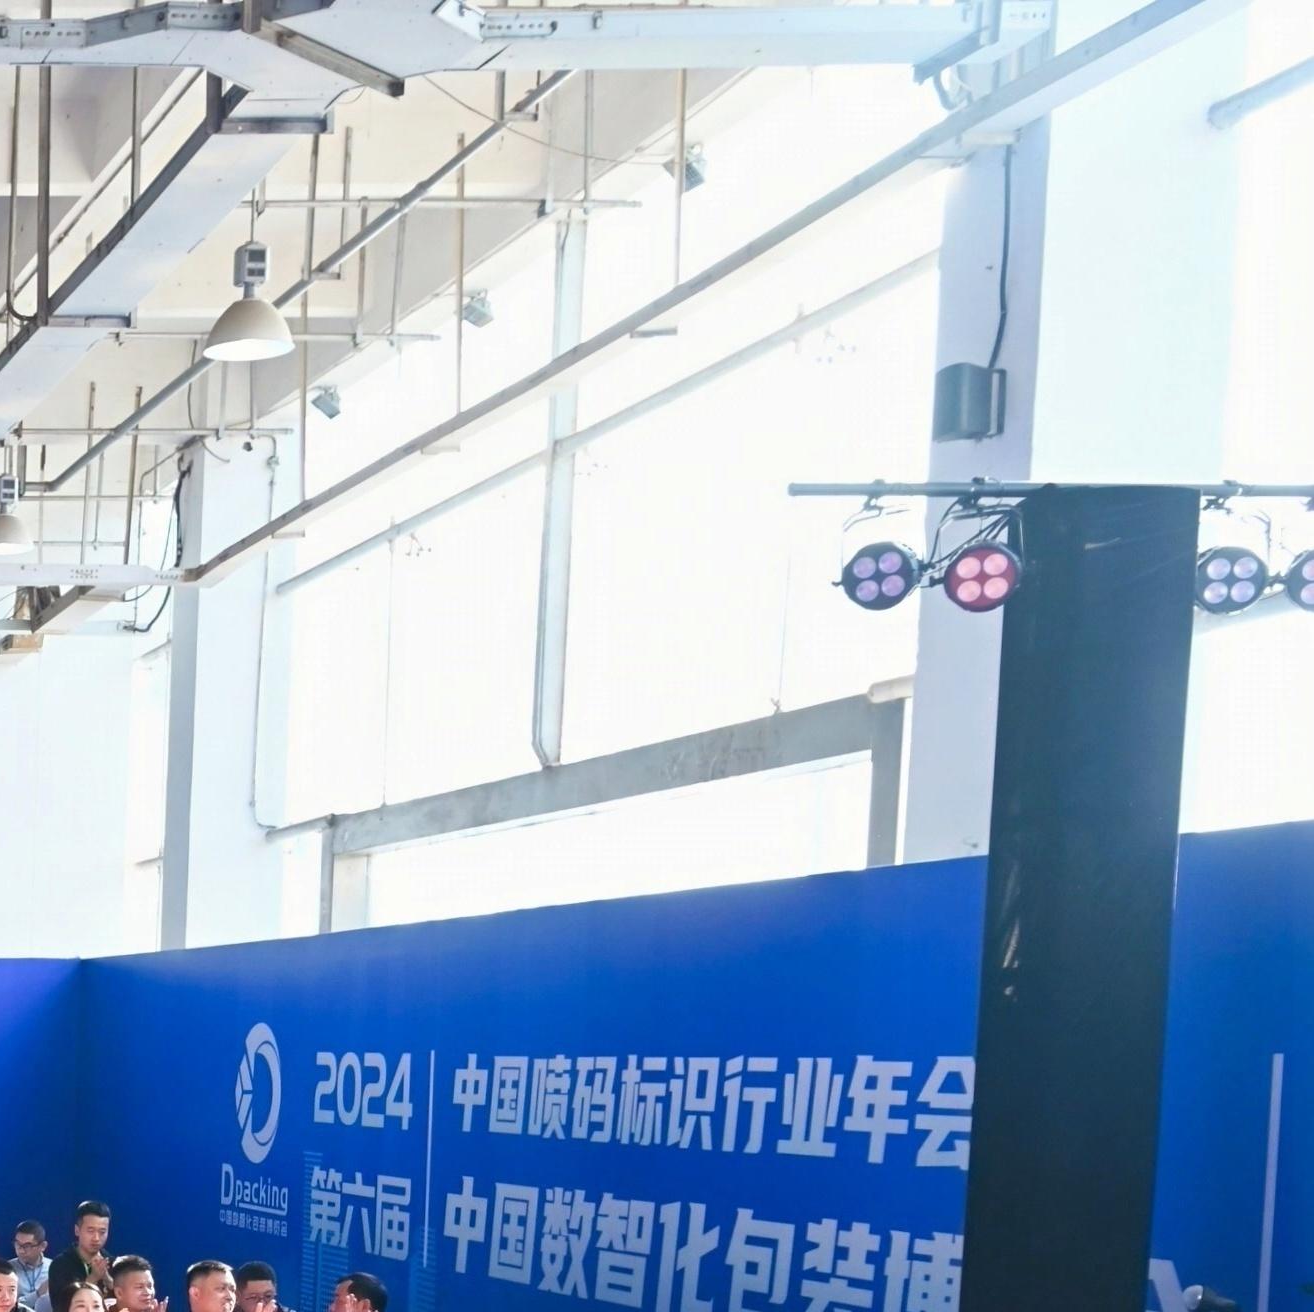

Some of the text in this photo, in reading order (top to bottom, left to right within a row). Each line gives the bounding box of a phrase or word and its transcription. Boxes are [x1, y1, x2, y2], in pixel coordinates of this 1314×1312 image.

[313, 1051, 413, 1130] 2024
[452, 1053, 973, 1170] 中国喷码标识行业年会
[220, 1162, 289, 1216] Dpacking
[309, 1165, 412, 1261] 第六届
